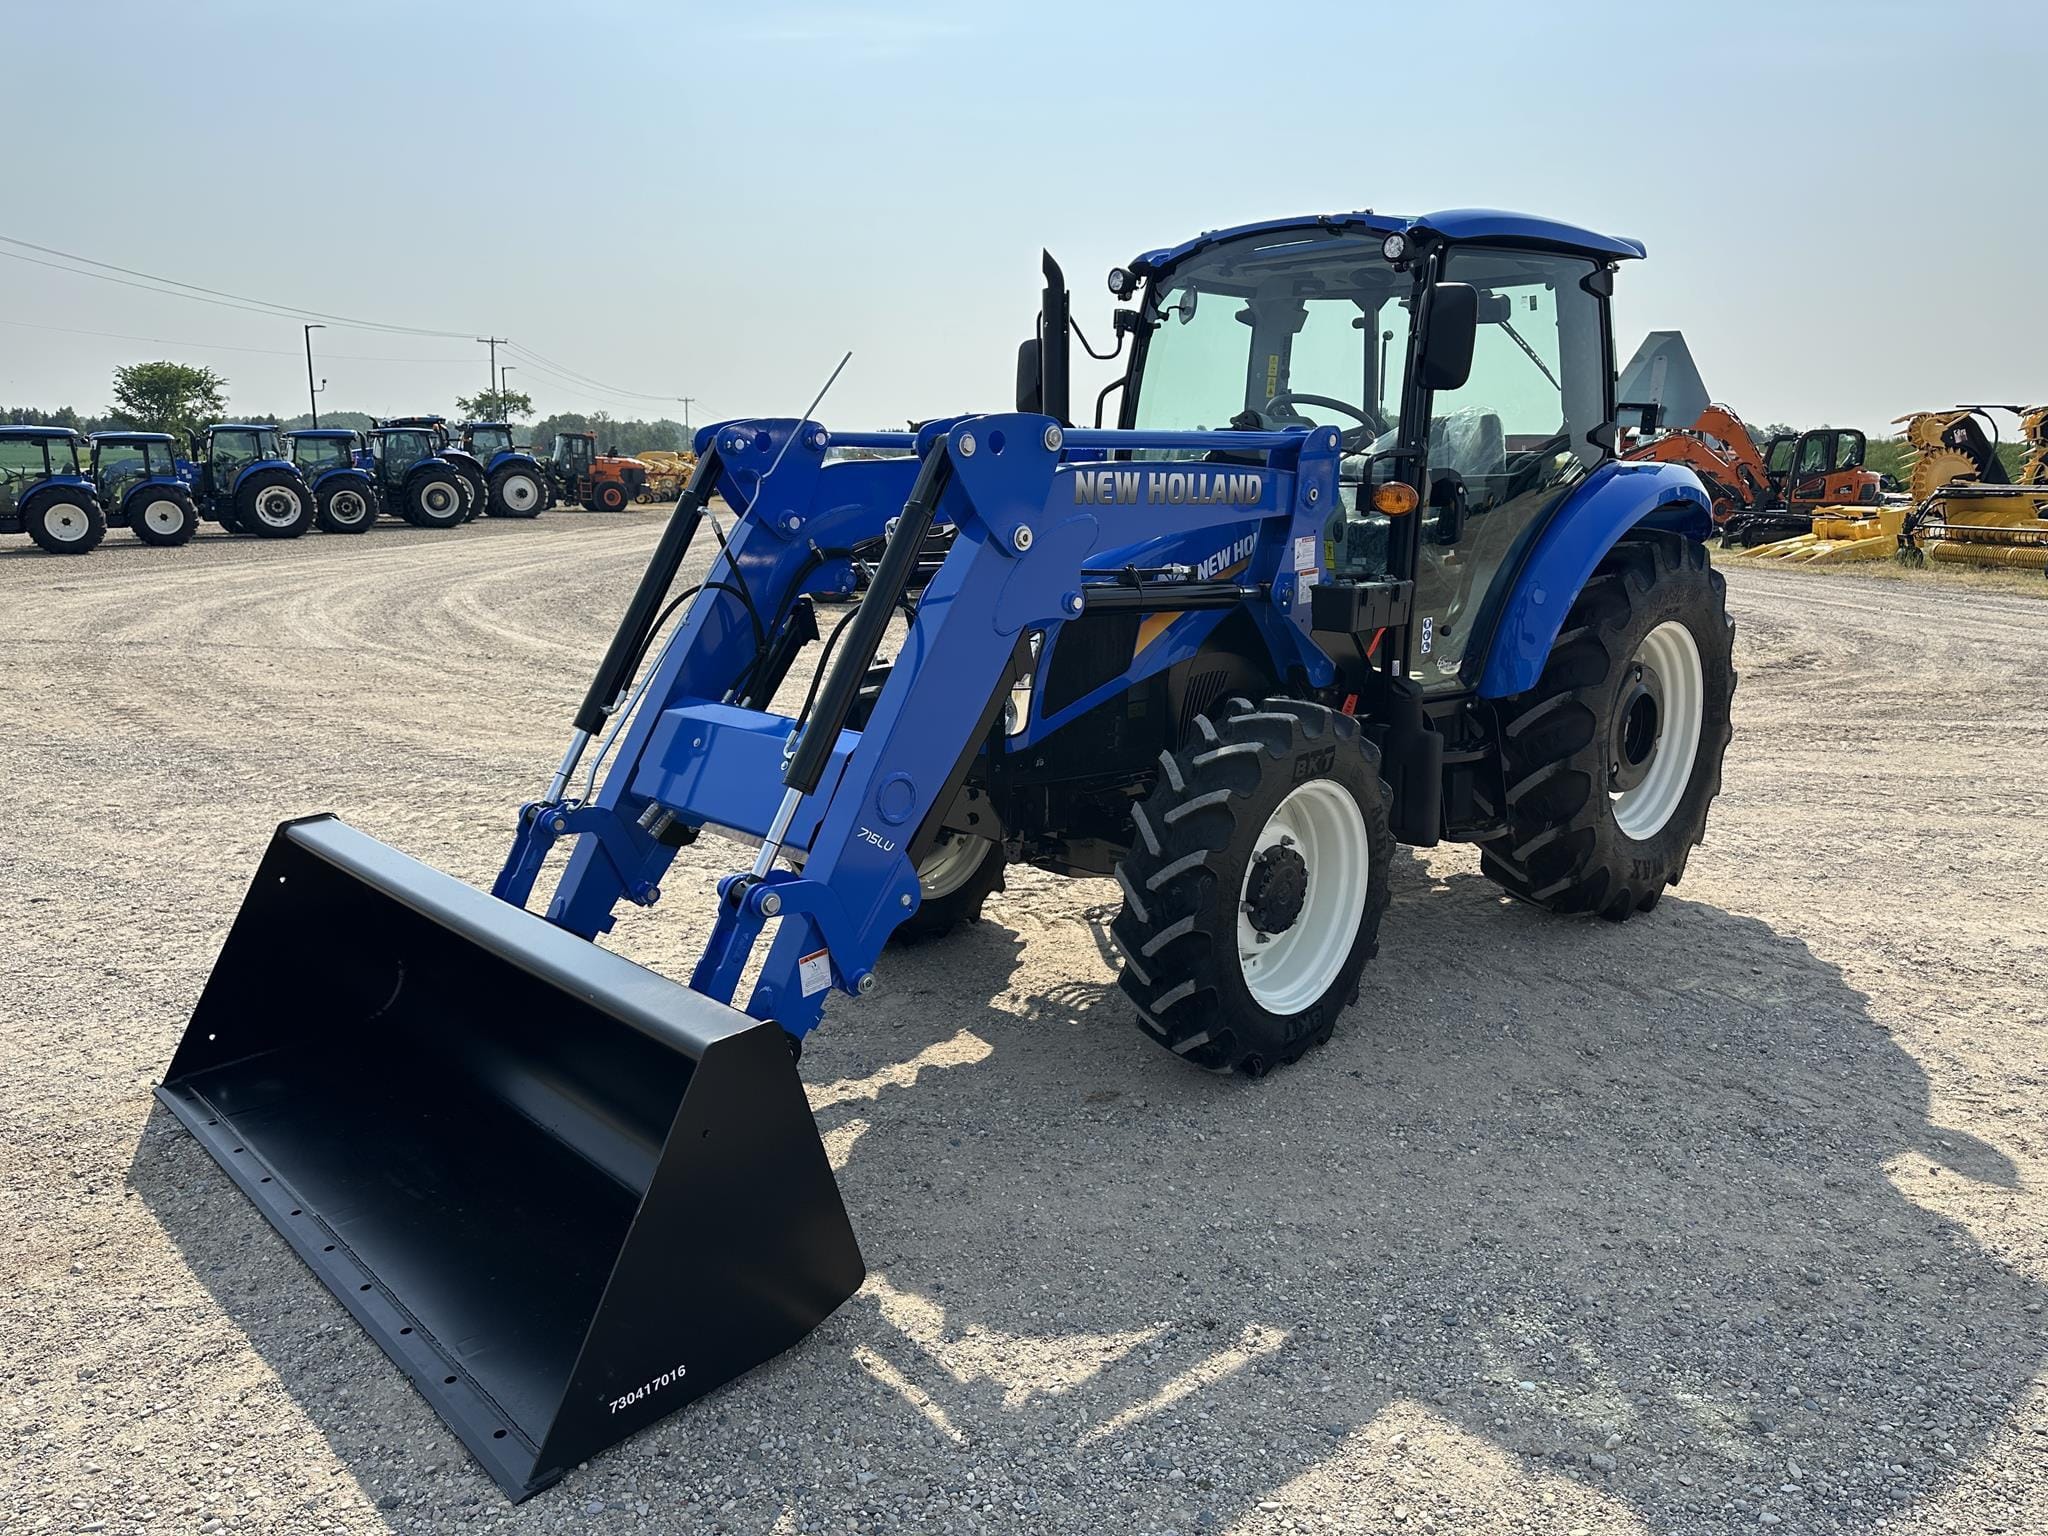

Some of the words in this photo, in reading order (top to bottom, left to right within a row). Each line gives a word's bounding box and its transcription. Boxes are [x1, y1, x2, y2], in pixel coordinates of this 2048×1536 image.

[1074, 471, 1140, 505] NEW
[1148, 472, 1262, 505] HOLLAND
[1197, 546, 1231, 580] NEW
[1294, 746, 1336, 780] BKT
[856, 827, 894, 852] 715LU
[609, 1364, 686, 1414] 730417016
